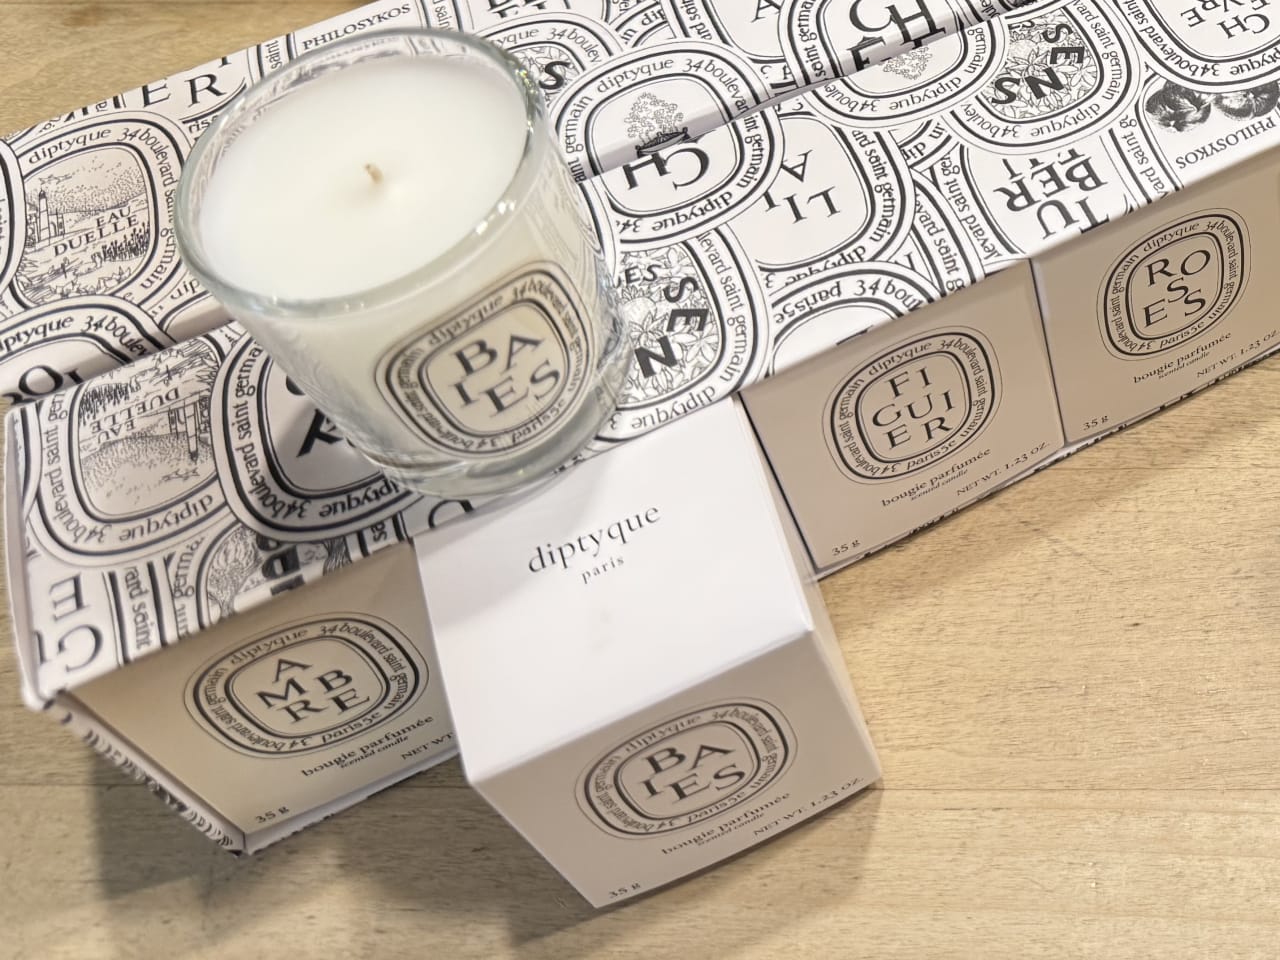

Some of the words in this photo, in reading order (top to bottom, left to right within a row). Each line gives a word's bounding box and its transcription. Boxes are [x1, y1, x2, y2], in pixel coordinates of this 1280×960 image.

[302, 3, 411, 51] PHILOSYKOS
[596, 57, 674, 94] diptyque
[990, 23, 1086, 107] SENS
[889, 76, 962, 111] diptyque
[1030, 102, 1101, 137] diptyque
[28, 127, 112, 165] diptyque
[1175, 116, 1277, 169] PHILOSYKOS
[95, 205, 133, 227] EAU
[652, 190, 733, 232] diptyque
[52, 215, 140, 258] DUELLE
[1143, 222, 1200, 253] diptyque
[1146, 249, 1211, 287] RO
[427, 295, 505, 347] diptyque
[454, 333, 547, 377] BA
[868, 342, 932, 376] diptyque
[1133, 361, 1174, 384] bougie
[1176, 332, 1232, 366] parfumée
[1196, 365, 1218, 378] NET
[1240, 341, 1261, 355] 1.23
[448, 358, 562, 420] IES
[885, 365, 933, 399] FI
[871, 391, 955, 428] GUI
[1083, 419, 1098, 431] 35
[883, 416, 953, 450] ER
[881, 481, 927, 507] bougie
[928, 448, 991, 487] parfumée
[955, 480, 981, 497] NET
[1003, 452, 1028, 470] 1.23
[118, 493, 215, 543] diptyque
[526, 506, 662, 575] diptyque
[831, 542, 849, 557] 35
[579, 555, 625, 585] paris
[299, 749, 357, 778] bougie
[359, 715, 434, 756] parfumée
[400, 744, 429, 761] NET
[641, 742, 736, 778] BA
[638, 763, 747, 806] IES
[255, 810, 277, 824] 35
[661, 825, 716, 856] bougie
[716, 790, 793, 833] parfumée
[608, 885, 629, 900] 35
